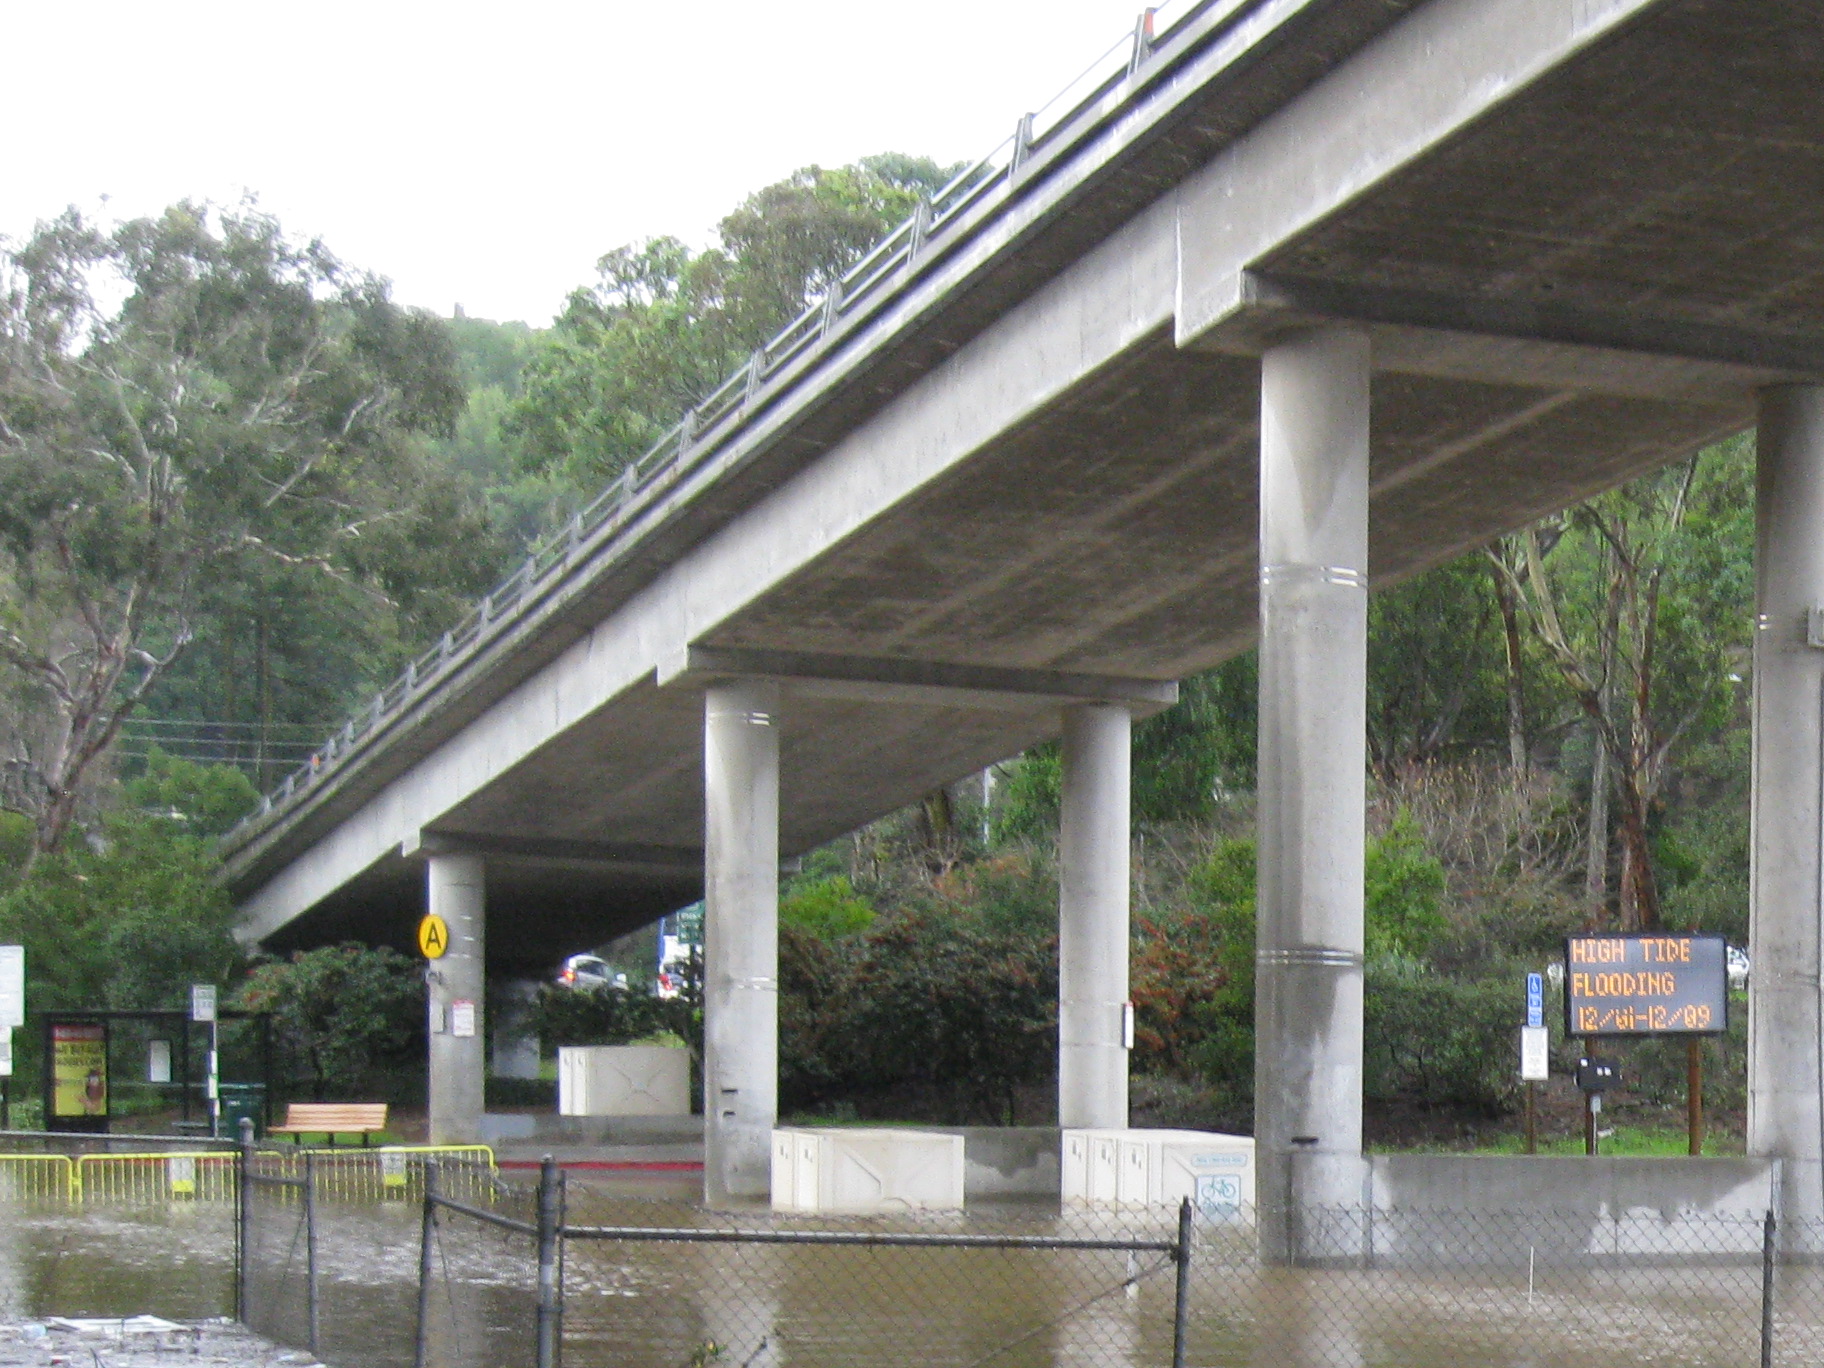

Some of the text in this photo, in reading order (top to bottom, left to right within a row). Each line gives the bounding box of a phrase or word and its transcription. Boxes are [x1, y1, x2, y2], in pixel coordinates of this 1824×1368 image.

[425, 921, 442, 949] A
[1572, 938, 1691, 963] HIGH TIDE
[1572, 972, 1676, 997] FLOODING
